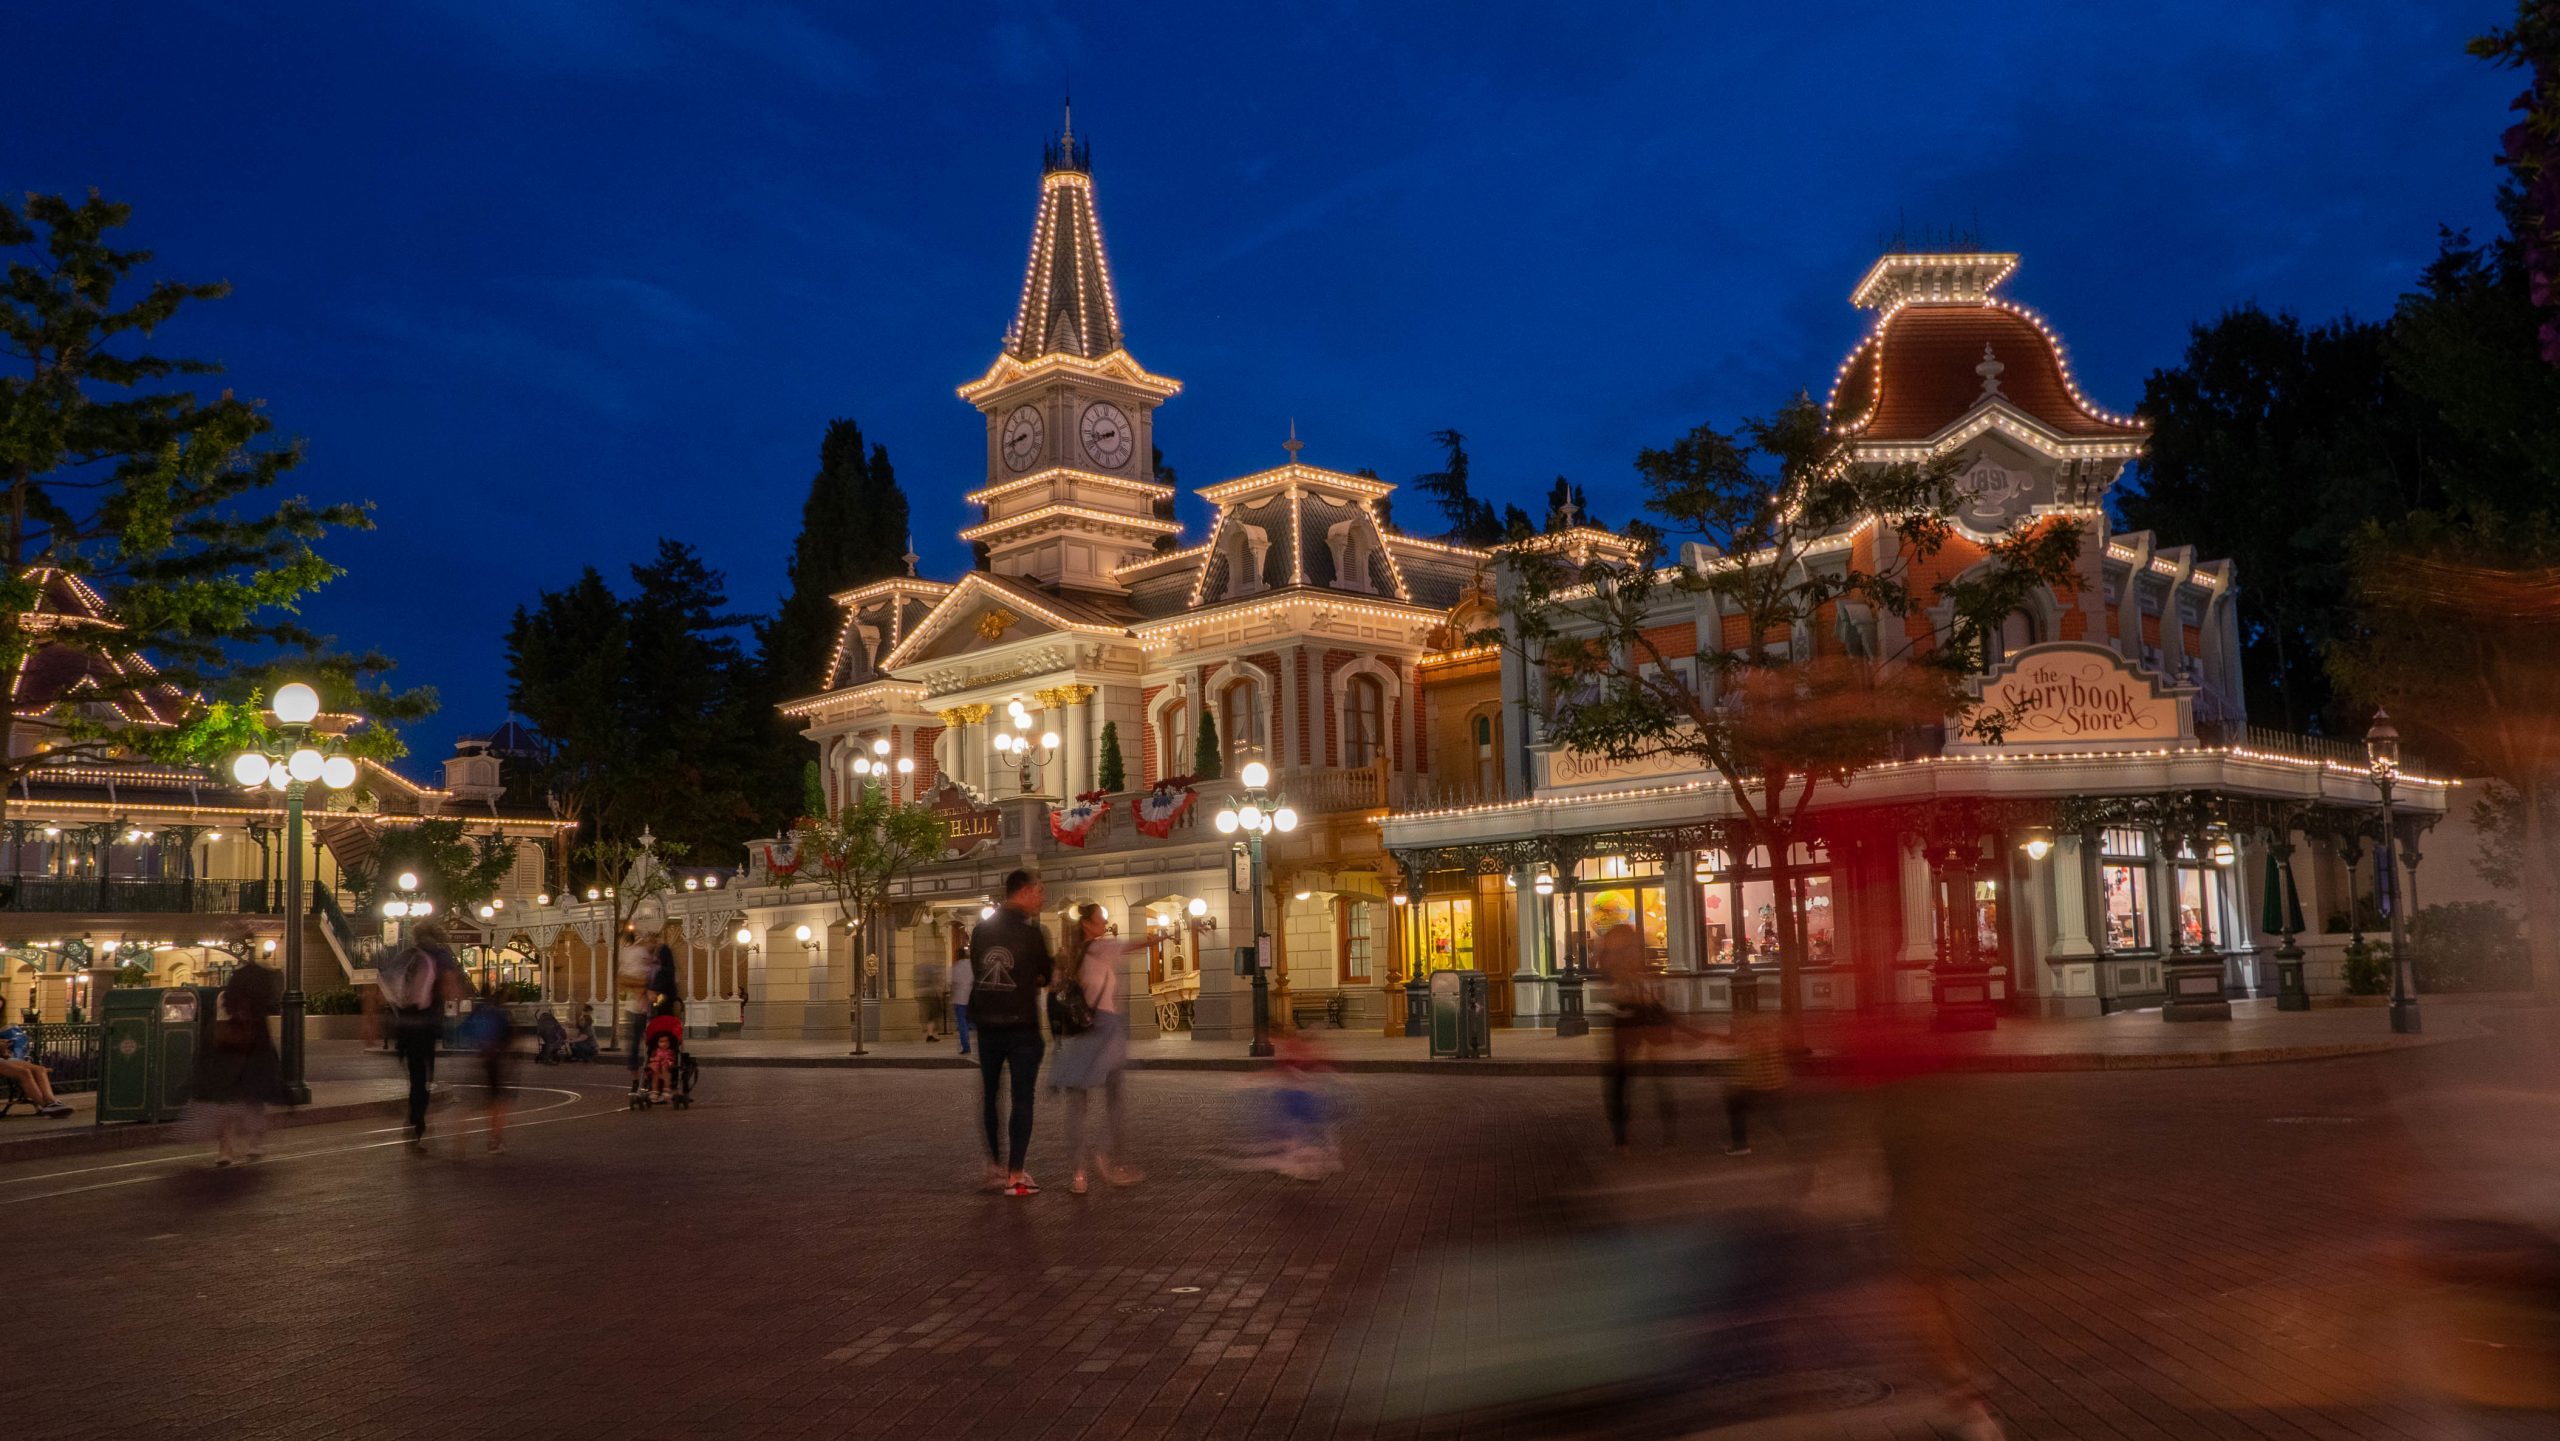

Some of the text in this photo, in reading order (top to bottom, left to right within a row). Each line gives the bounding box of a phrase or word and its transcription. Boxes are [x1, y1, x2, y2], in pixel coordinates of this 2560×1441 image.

[1971, 468, 2009, 491] 1891
[2031, 667, 2058, 685] the
[2002, 675, 2147, 727] Storybook
[2062, 706, 2124, 735] Store
[950, 817, 993, 838] HALL
